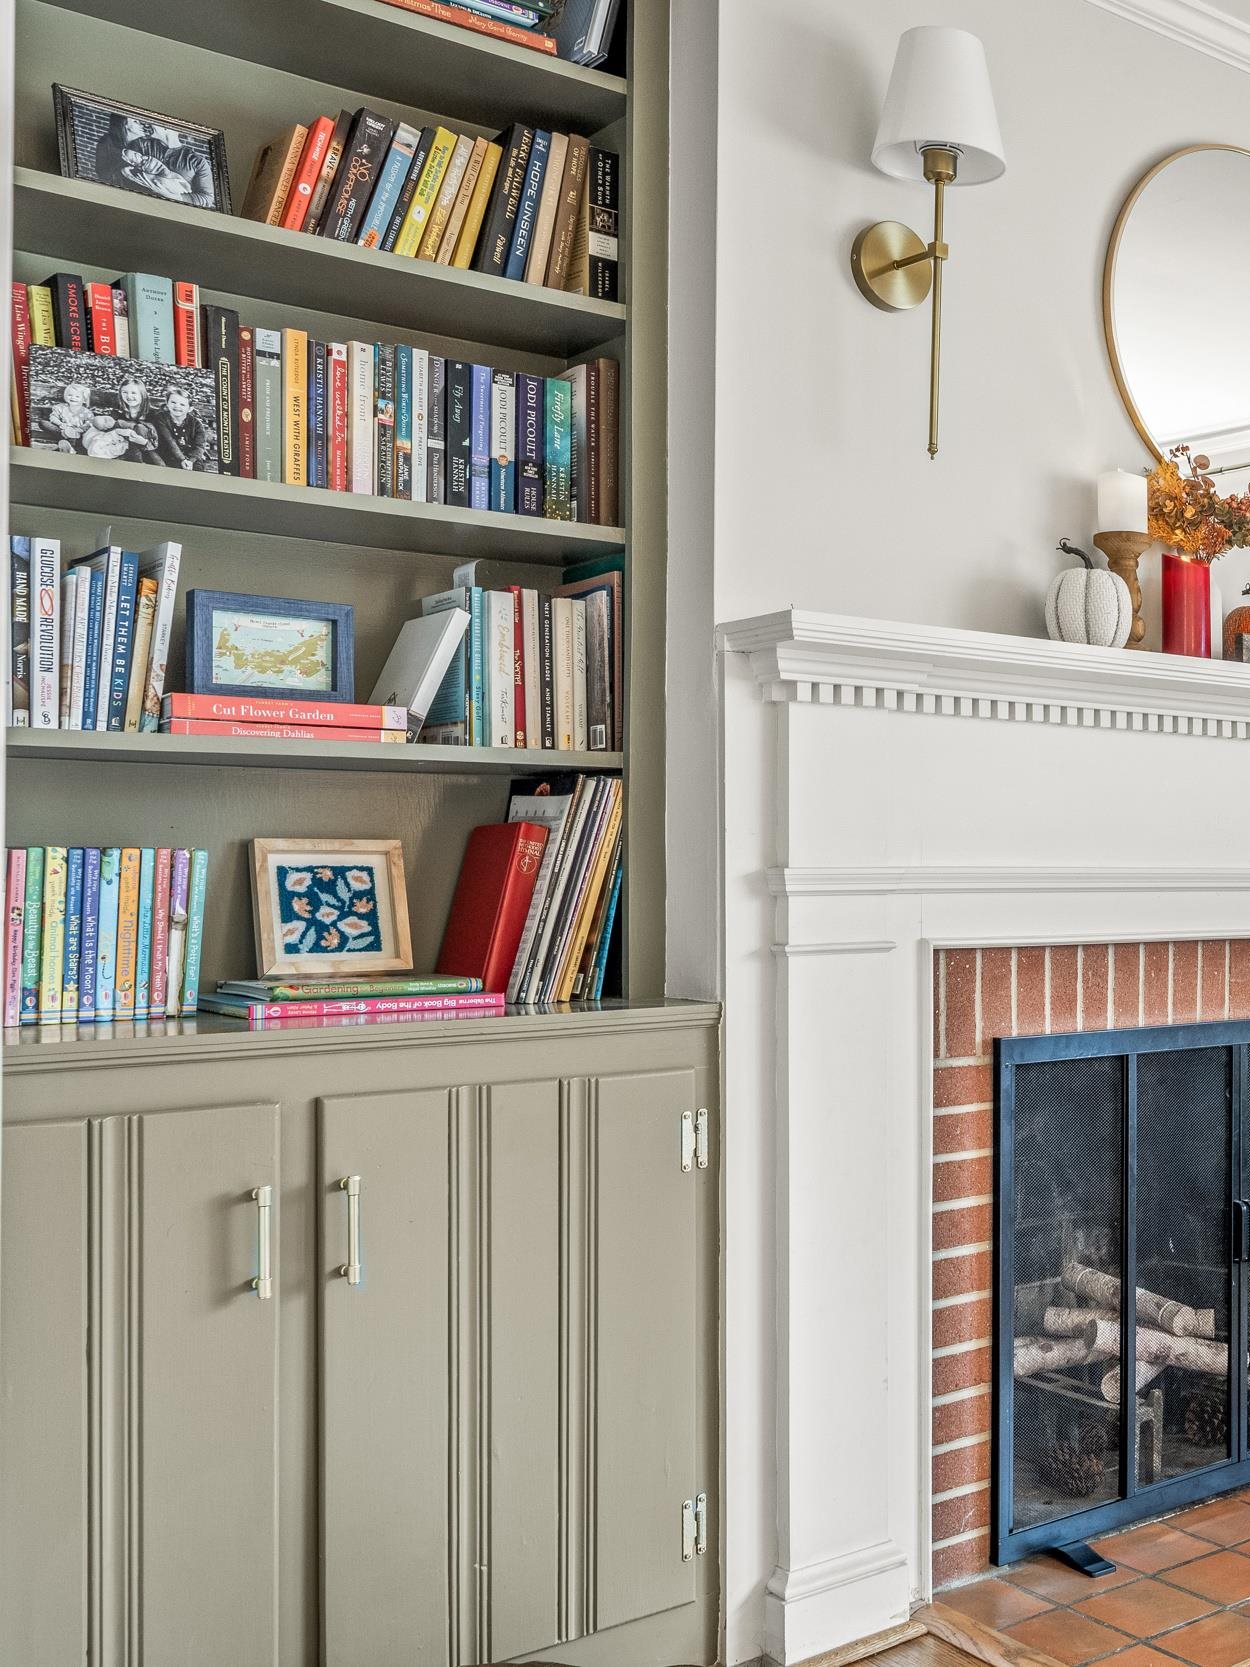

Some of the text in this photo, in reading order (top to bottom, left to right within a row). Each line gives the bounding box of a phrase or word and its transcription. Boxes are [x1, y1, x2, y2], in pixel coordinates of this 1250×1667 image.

[410, 150, 425, 180] ADVENTURING
[573, 147, 579, 157] OF
[356, 159, 371, 182] NO
[464, 172, 474, 191] Carry
[505, 129, 532, 219] JERRY FALWELL
[336, 155, 360, 217] COMPROMISE
[502, 176, 511, 194] Legacy
[338, 197, 356, 241] KEITH GREEN
[515, 160, 541, 256] HOPE UNSEEN
[492, 233, 506, 264] Falwell
[142, 287, 167, 296] ANTHONY
[67, 283, 80, 351] SMOKE SCREE
[335, 365, 343, 444] love walked in
[358, 360, 368, 421] home front
[452, 385, 462, 423] Fly Away
[498, 387, 509, 409] JODI
[526, 379, 536, 406] JODI
[498, 411, 507, 451] PICOULT
[551, 390, 563, 449] Firefly Lane
[526, 410, 535, 458] PICOULT
[16, 572, 26, 622] HAND MADE
[39, 548, 53, 672] GLUCOSE REVOLUTION
[112, 595, 130, 706] LET THEM BE KIDS
[497, 624, 510, 677] Embraced
[16, 654, 25, 678] Norris
[514, 660, 522, 684] Secret
[212, 703, 333, 721] Cut Flower Garden
[231, 725, 314, 738] Discovering Dahlias
[24, 901, 40, 933] Beauty
[85, 915, 94, 936] What
[142, 921, 150, 939] Little
[68, 915, 79, 978] What are Stars?
[84, 950, 93, 964] the
[140, 944, 149, 974] Mermaid
[188, 915, 199, 980] What's Potty For?
[25, 950, 38, 976] Beast
[48, 956, 57, 984] homes
[84, 967, 94, 993] Moon?
[155, 972, 163, 990] Teeth?
[301, 985, 359, 996] Gardening
[376, 1001, 398, 1009] Body
[400, 1001, 412, 1009] the
[444, 999, 456, 1007] Big
